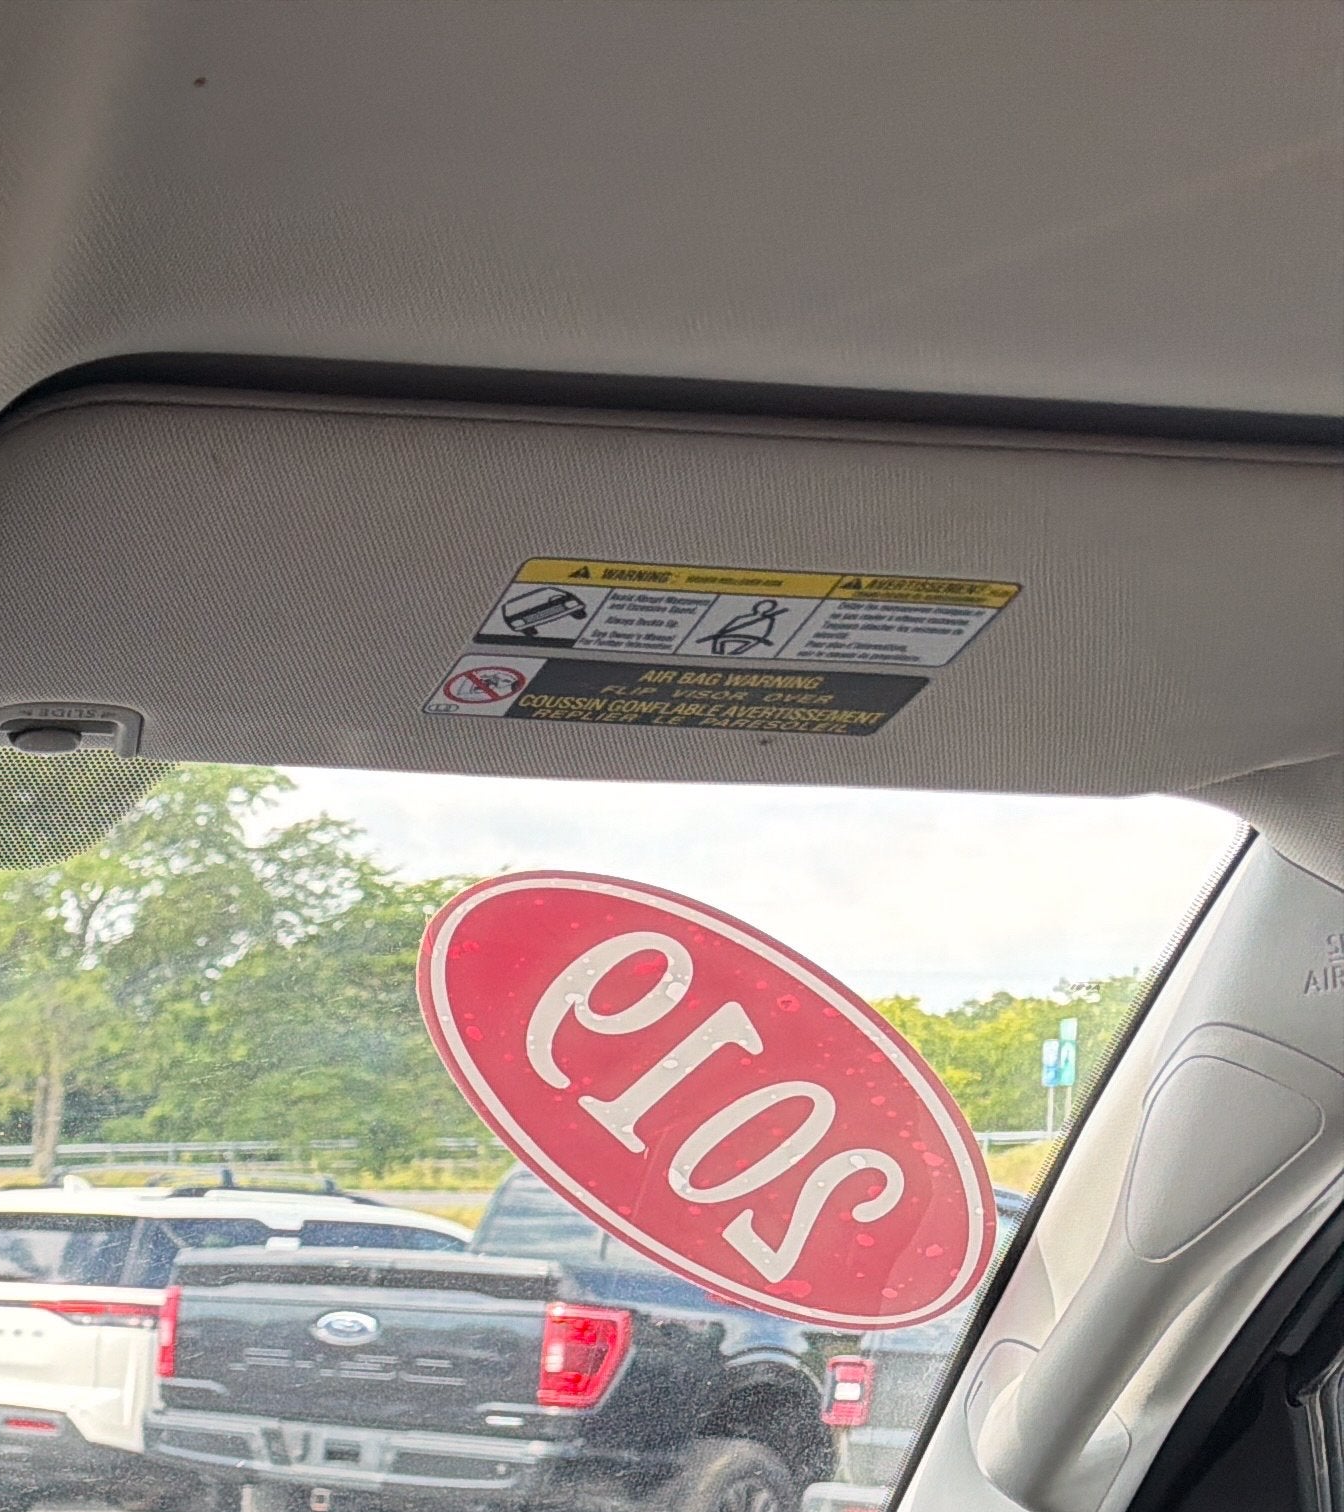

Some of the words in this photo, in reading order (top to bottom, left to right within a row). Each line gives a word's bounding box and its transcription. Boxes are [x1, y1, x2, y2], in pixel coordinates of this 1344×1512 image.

[640, 670, 677, 683] AIR
[678, 672, 723, 685] BAG
[723, 674, 824, 689] WARNING
[601, 686, 657, 696] FLIP
[672, 689, 749, 701] VISOR
[764, 693, 834, 703] OVER
[519, 694, 602, 708] COUSSIN
[608, 700, 724, 716] GONFLABLE
[724, 707, 887, 724] AVERTISSEMENT
[532, 709, 638, 722] REPLIER
[654, 716, 686, 725] LE
[698, 717, 851, 733] PARESOLEIL
